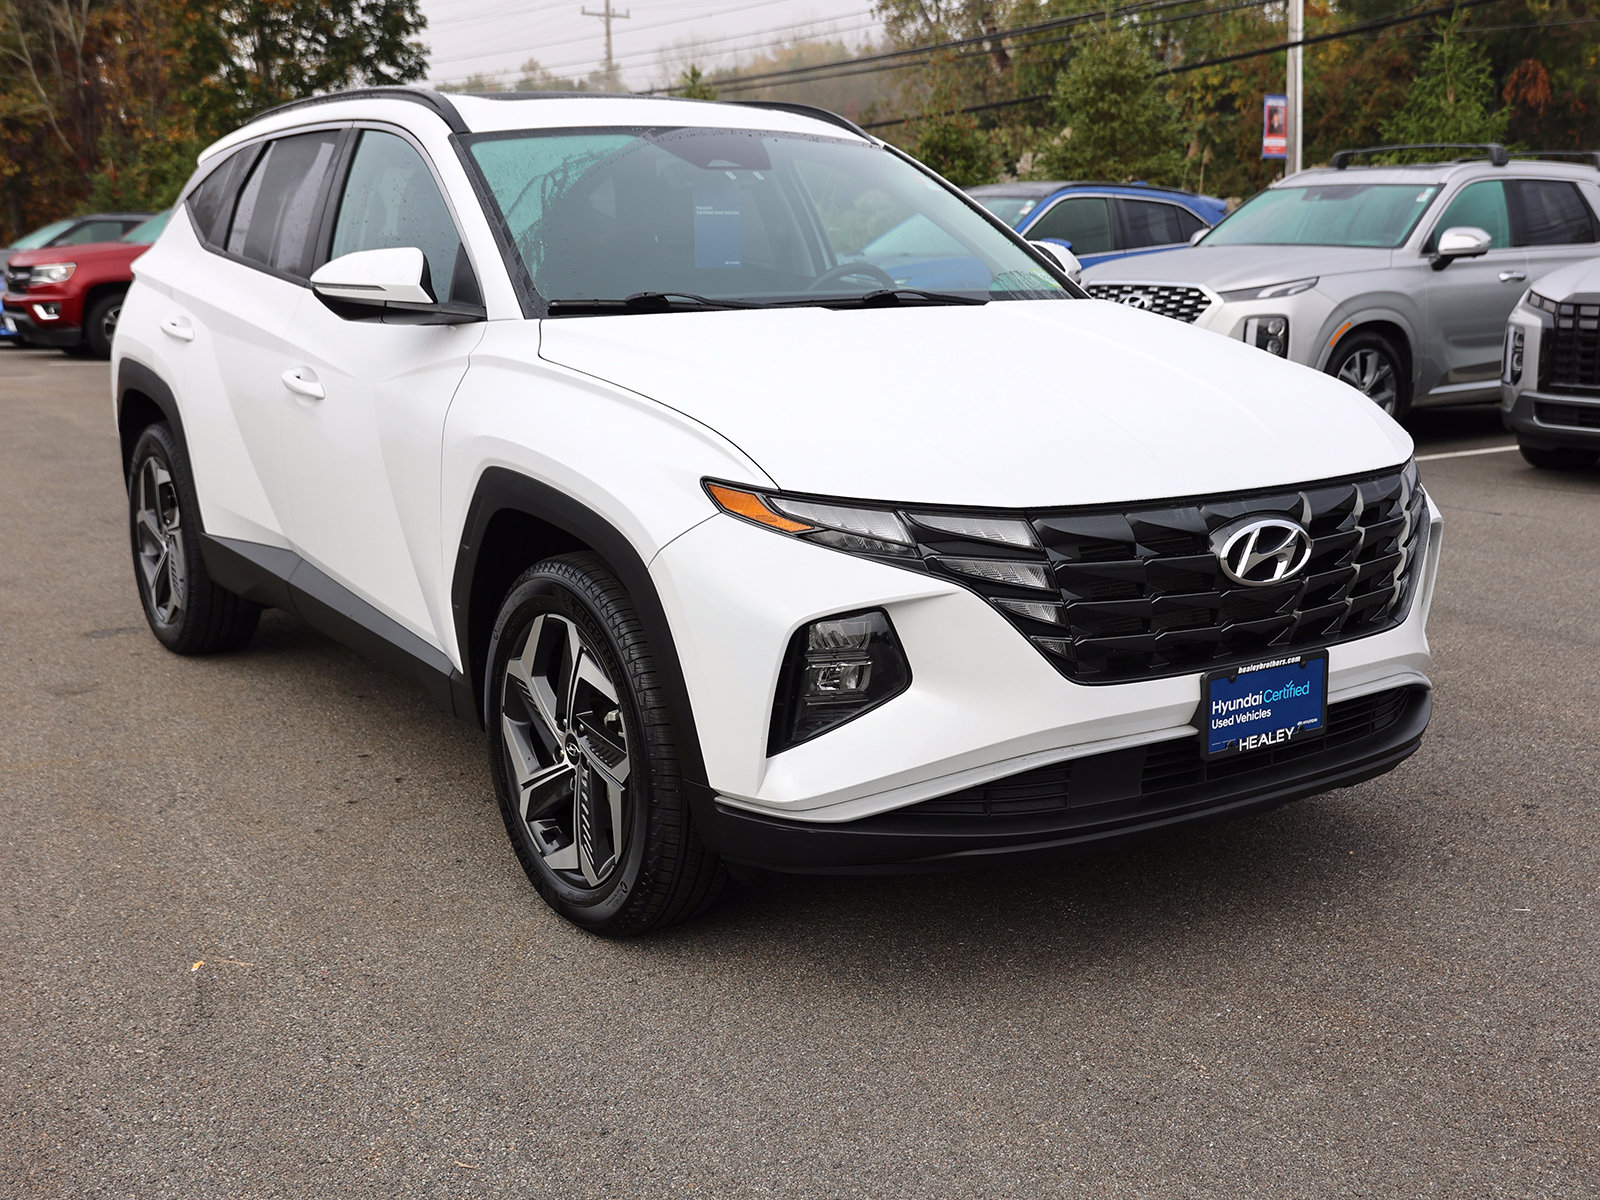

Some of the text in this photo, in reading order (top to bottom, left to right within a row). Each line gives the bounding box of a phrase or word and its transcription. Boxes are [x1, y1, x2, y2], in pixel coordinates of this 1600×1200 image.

[1237, 655, 1302, 674] healeybrothers.com
[1211, 680, 1310, 716] Hyundai Certified
[1211, 708, 1272, 730] Used Vehicles
[1238, 726, 1295, 752] HEALEY
